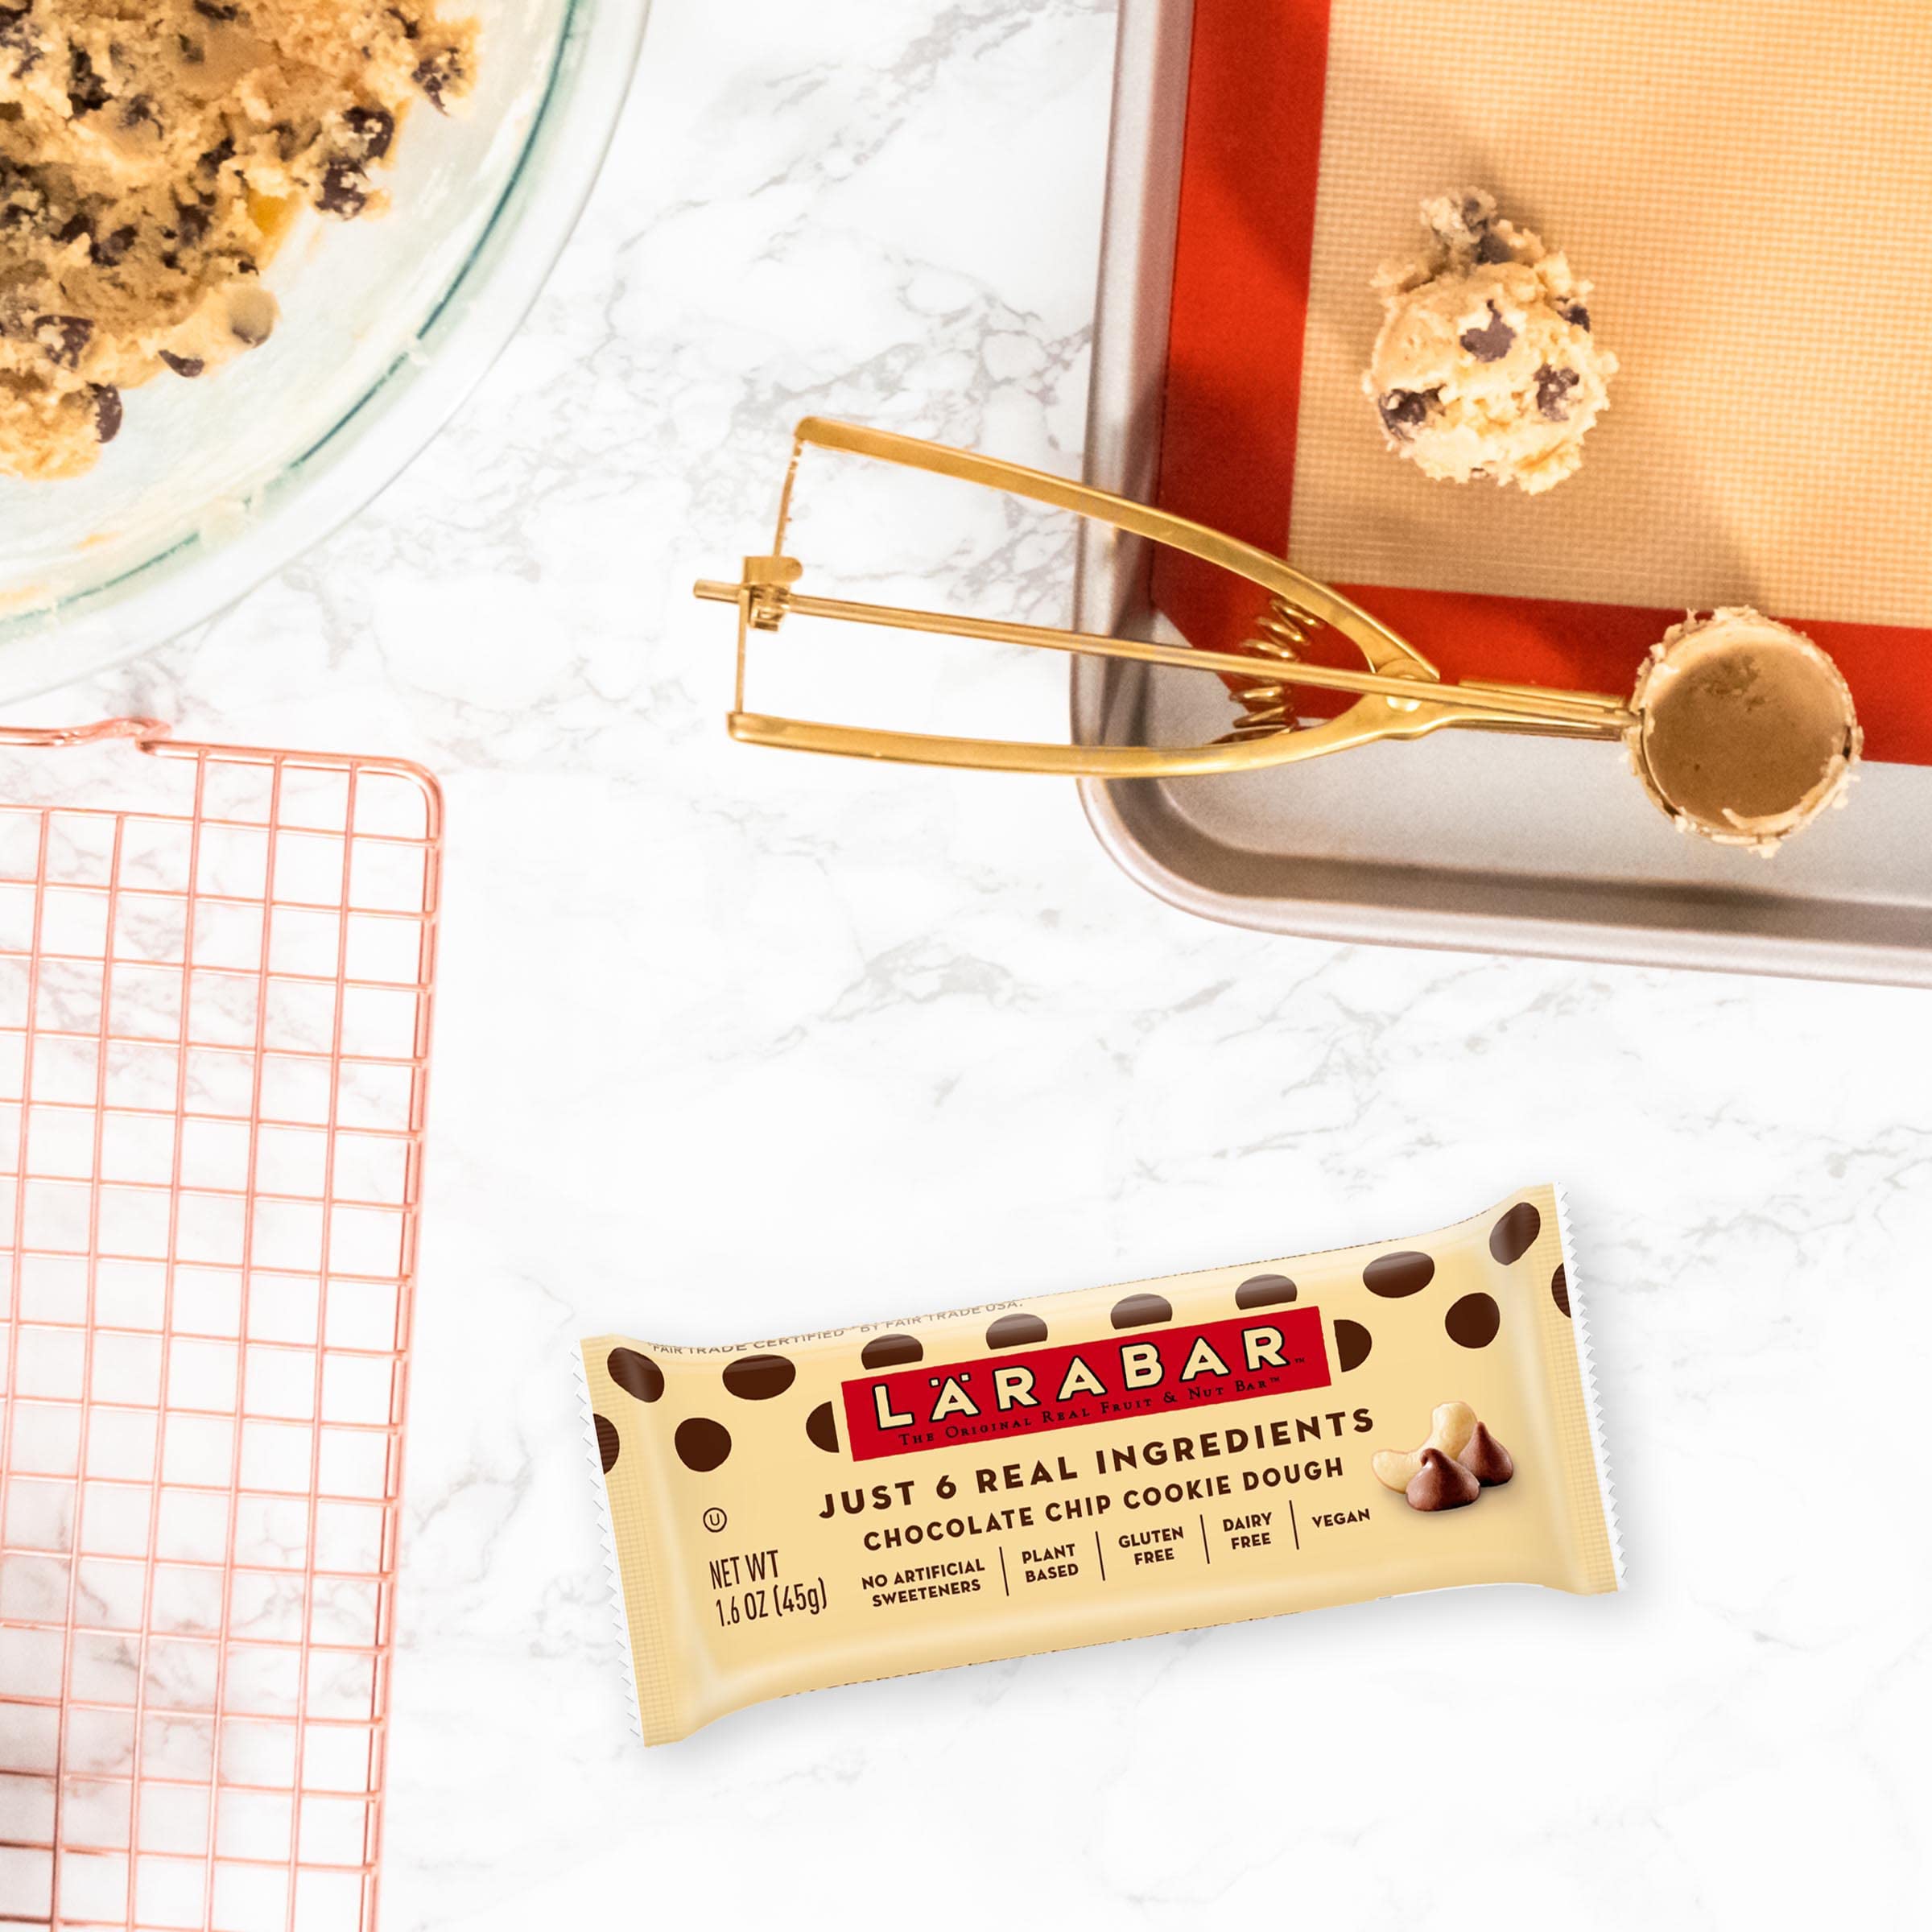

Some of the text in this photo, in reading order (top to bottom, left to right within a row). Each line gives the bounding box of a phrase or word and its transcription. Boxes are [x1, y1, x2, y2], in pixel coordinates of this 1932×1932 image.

[687, 1342, 748, 1354] TRADE
[927, 1306, 981, 1321] TRADE
[1163, 1391, 1178, 1404] &
[819, 1409, 1373, 1519] JUST 6 REAL INGREDIENTS
[864, 1457, 1344, 1551] CHOCOLATE CHIP COOKIE DOUGH
[1223, 1512, 1272, 1532] DAIRY
[1312, 1509, 1370, 1528] VEGAN
[1119, 1526, 1183, 1548] GLUTEN
[1232, 1533, 1271, 1550] FREE
[1022, 1544, 1075, 1564] PLANT
[1134, 1548, 1174, 1565] FREE
[709, 1550, 778, 1590] NET WT
[862, 1558, 985, 1590] NO ARTIFICIAL
[1026, 1564, 1079, 1583] BASED
[716, 1577, 828, 1627] 1.6 OZ (45g)
[873, 1579, 981, 1607] SWEETENERS
